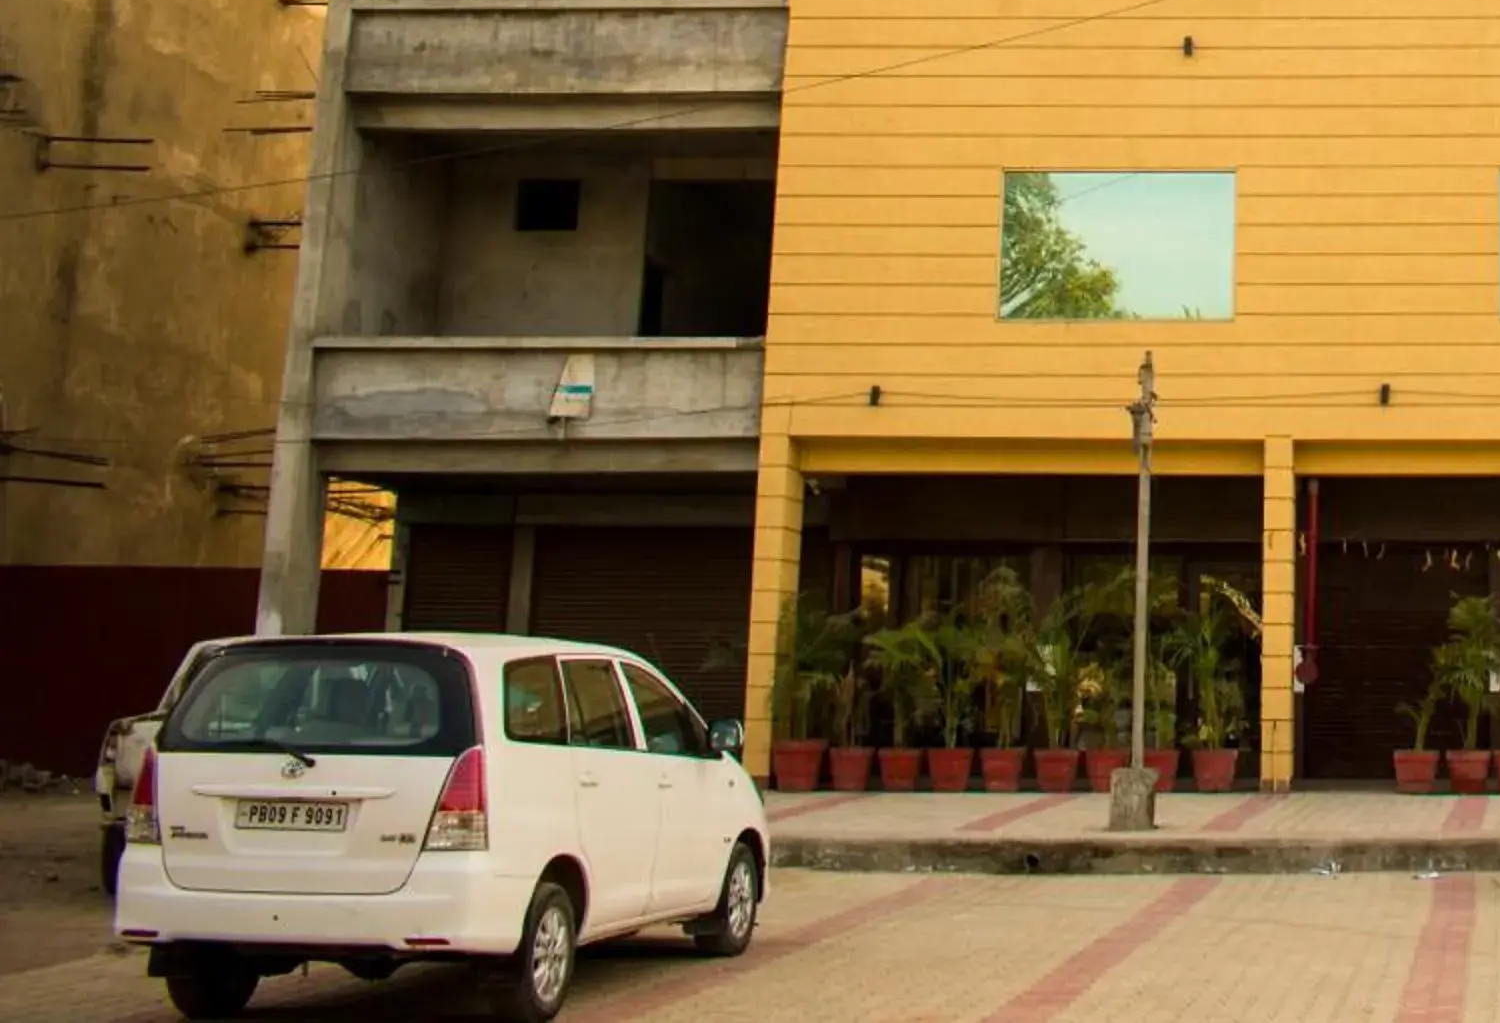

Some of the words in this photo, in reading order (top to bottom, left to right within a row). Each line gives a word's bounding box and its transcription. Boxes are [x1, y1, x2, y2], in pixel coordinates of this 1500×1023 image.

[249, 805, 287, 823] PB09
[291, 807, 300, 823] F
[305, 807, 343, 825] 9091
